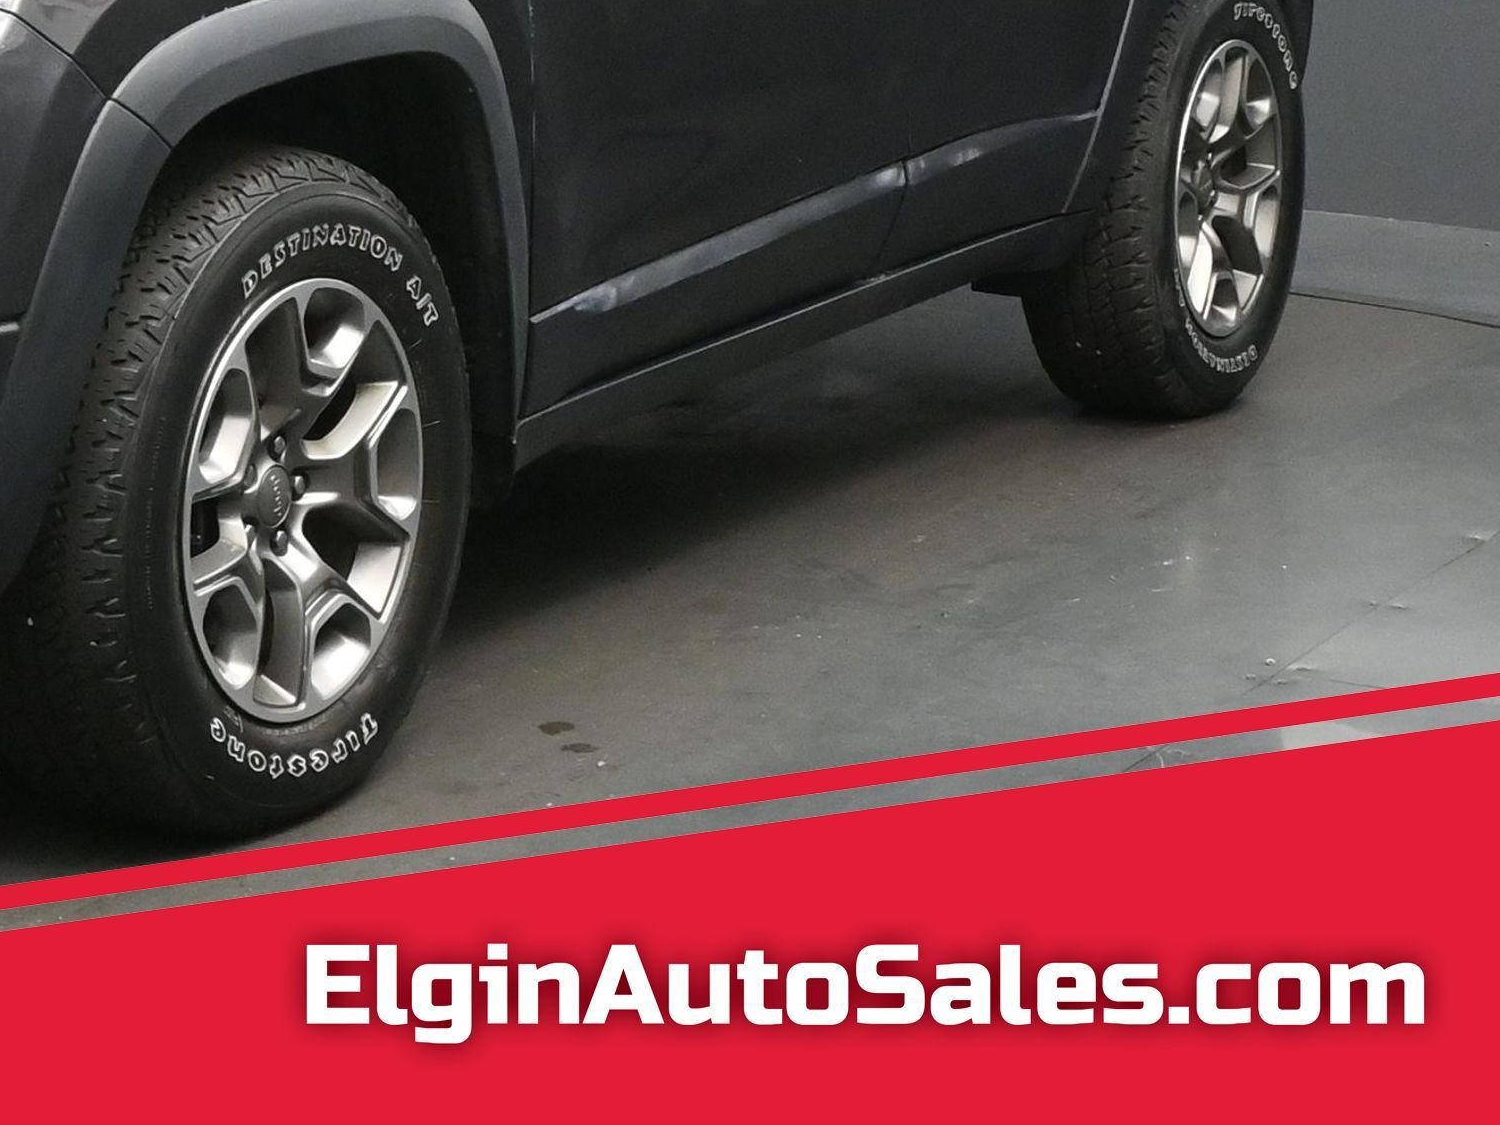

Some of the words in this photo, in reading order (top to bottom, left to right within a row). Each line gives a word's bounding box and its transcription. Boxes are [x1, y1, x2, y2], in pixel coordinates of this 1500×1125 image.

[241, 224, 403, 300] DESTINATION
[406, 275, 440, 327] A/T
[210, 713, 378, 780] Firestone
